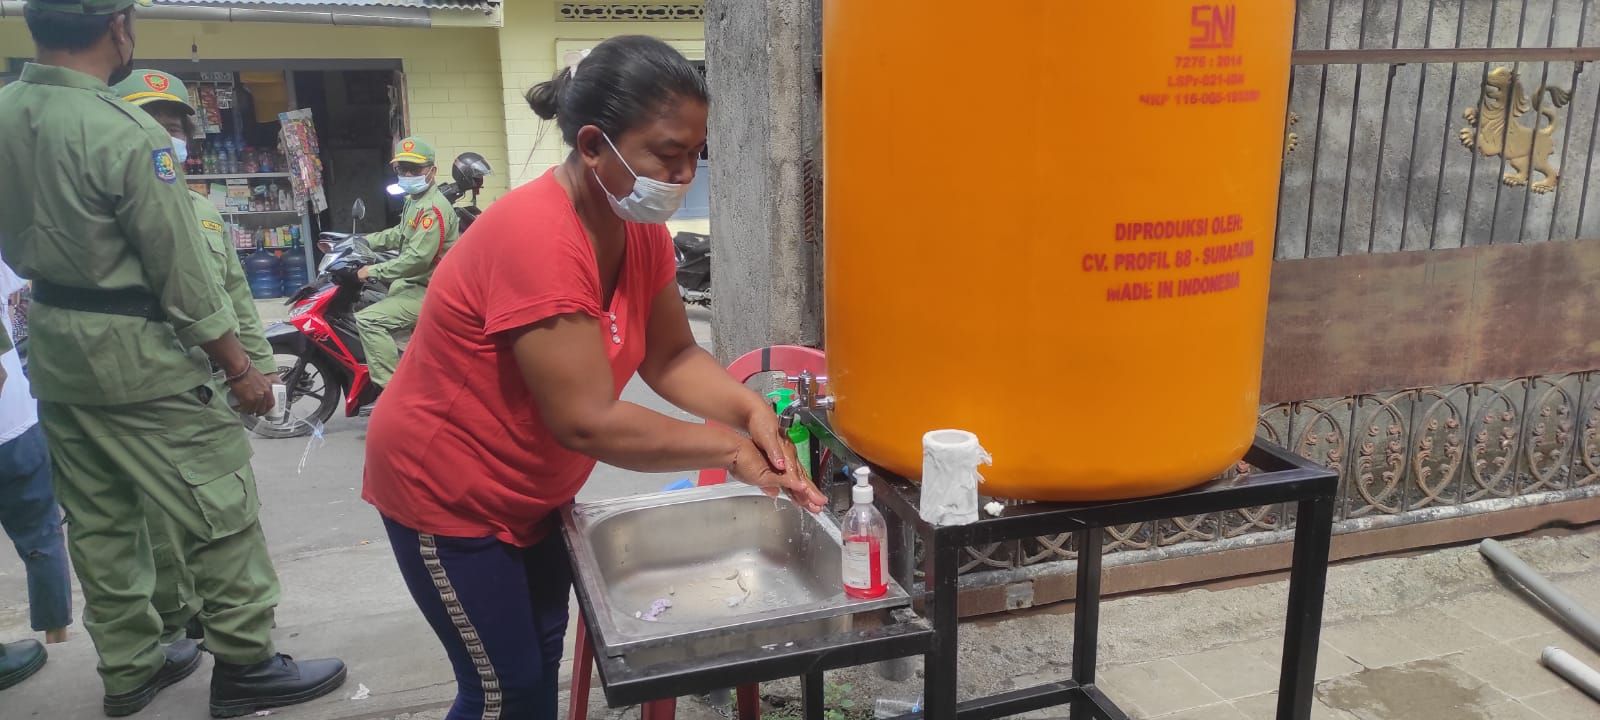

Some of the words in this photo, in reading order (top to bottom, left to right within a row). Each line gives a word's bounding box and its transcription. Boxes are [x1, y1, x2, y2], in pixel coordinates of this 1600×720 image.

[1115, 217, 1209, 241] DIPRODUKSI
[1212, 214, 1243, 235] OLEH:
[1082, 253, 1109, 272] CV.
[1114, 251, 1170, 271] PROFIL
[1175, 249, 1192, 268] 88
[1106, 281, 1153, 302] MADE
[1158, 280, 1173, 299] IN
[1177, 271, 1240, 297] INDONESIA
